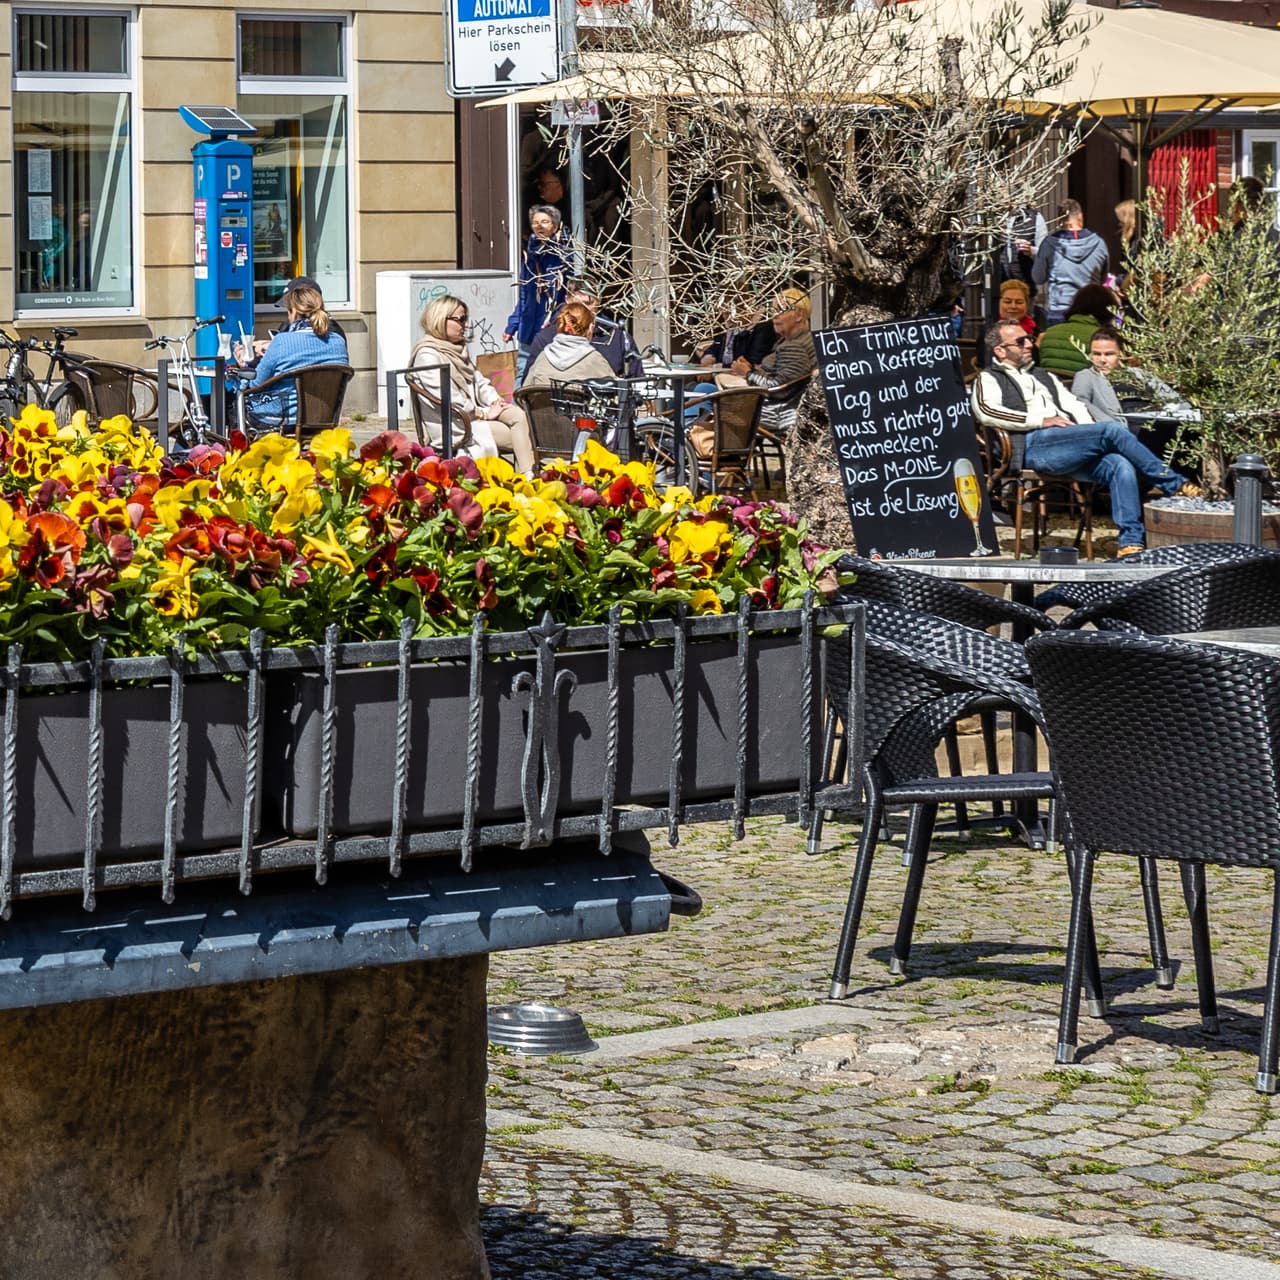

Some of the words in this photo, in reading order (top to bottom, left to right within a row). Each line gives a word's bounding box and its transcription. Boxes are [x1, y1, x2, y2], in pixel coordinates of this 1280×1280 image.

[458, 26, 482, 39] Hier
[487, 22, 551, 37] Parkschein
[489, 39, 521, 52] lösen
[227, 164, 241, 189] P
[815, 330, 849, 356] Ich
[860, 322, 919, 351] trinke
[922, 322, 951, 340] nur
[824, 359, 872, 381] einen
[827, 384, 871, 418] Tag
[879, 379, 908, 407] und
[915, 376, 942, 394] der
[835, 420, 877, 438] muss
[884, 403, 943, 436] richtig
[946, 399, 972, 428] gut
[840, 433, 939, 460] schmecken.
[845, 466, 878, 485] Das
[884, 455, 942, 481] M-ONE
[850, 497, 875, 517] ist
[880, 490, 904, 517] die
[906, 486, 960, 519] Lösung
